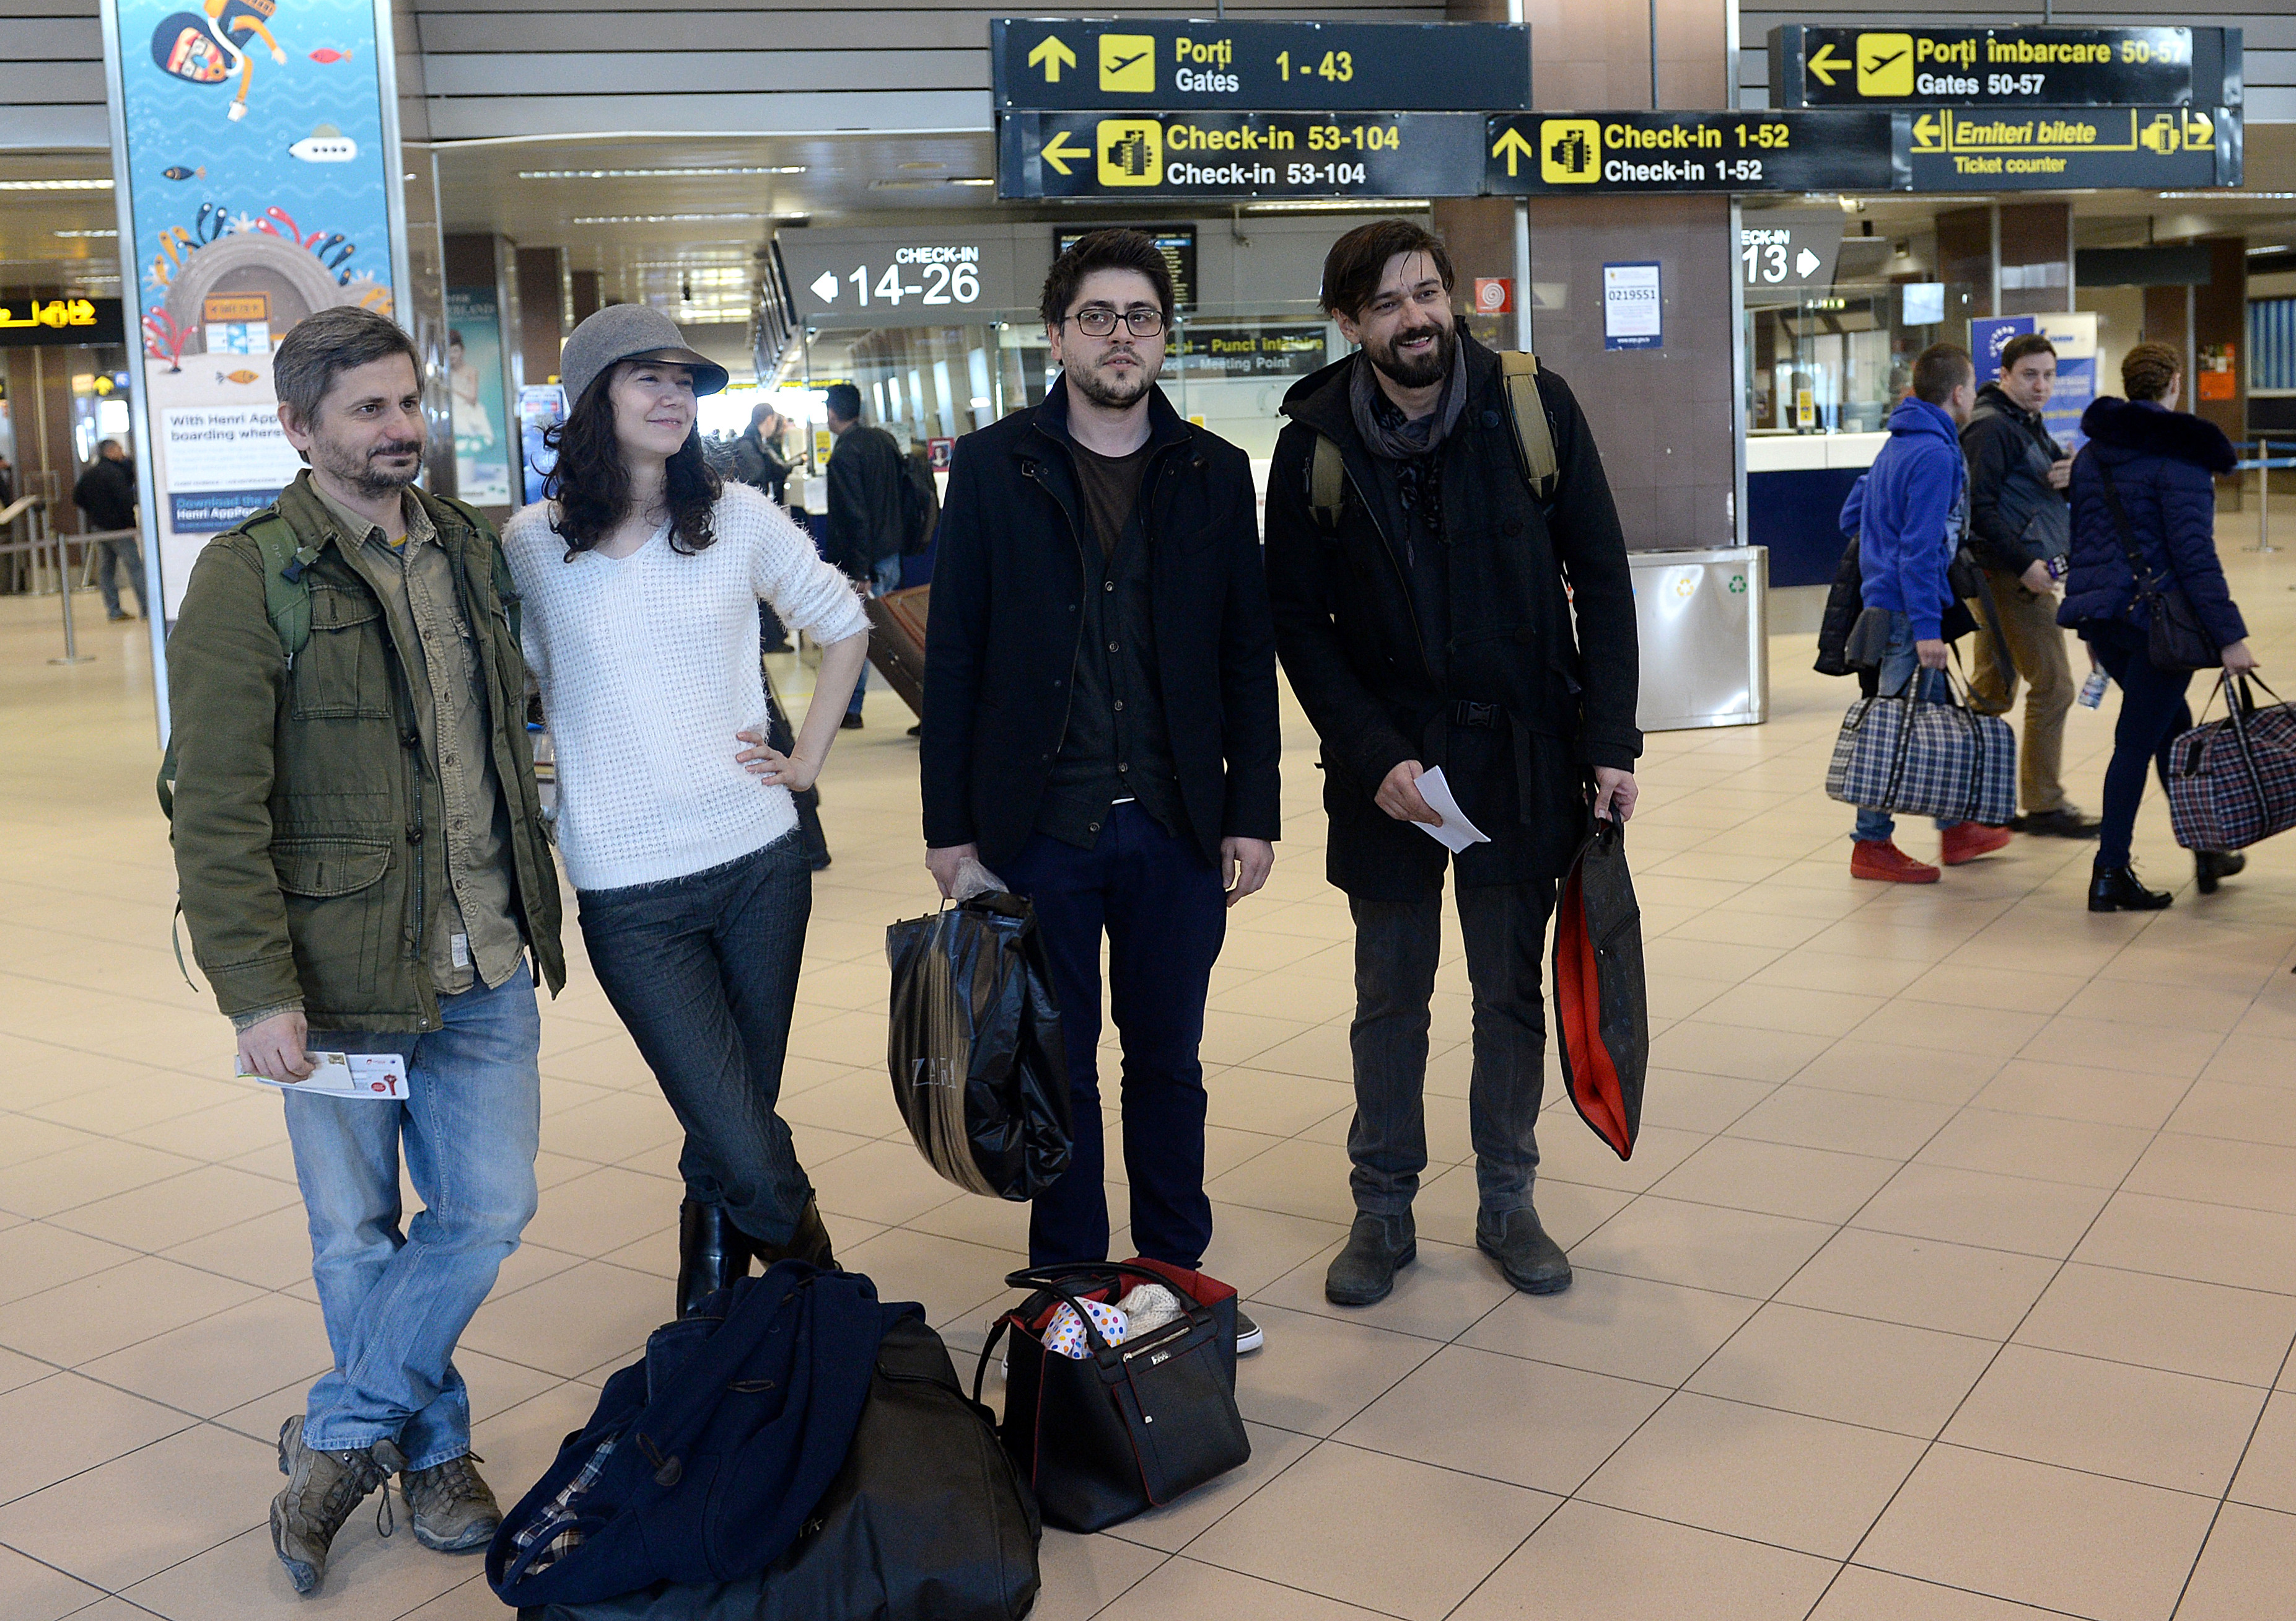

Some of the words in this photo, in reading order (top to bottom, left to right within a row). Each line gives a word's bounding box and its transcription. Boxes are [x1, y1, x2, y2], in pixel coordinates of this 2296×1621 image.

[1176, 37, 1232, 71] Porți
[1276, 51, 1289, 81] 1
[1318, 51, 1354, 82] 43
[1917, 38, 1976, 71] Porți
[1986, 38, 2111, 63] îmbarcare
[2121, 40, 2186, 63] 50-57
[1175, 68, 1239, 92] Gates
[1917, 73, 1979, 95] Gates
[1987, 74, 2045, 95] 50-57
[1167, 125, 1294, 150] Check-in
[1308, 125, 1400, 150] 53-104
[1604, 124, 1722, 149] Check-in
[1735, 123, 1790, 148] 1-52
[1955, 121, 2033, 144] Emiteri
[2037, 121, 2097, 143] bilete
[1167, 162, 1276, 185] Check-in
[1287, 163, 1366, 185] 53-104
[1605, 159, 1705, 182] Check-in
[1715, 159, 1763, 180] 1-52
[1953, 156, 2003, 174] Ticket
[2005, 157, 2067, 173] counter
[896, 246, 979, 264] CHECK-IN
[1742, 244, 1788, 283] 13
[849, 261, 980, 307] 14-26
[1609, 289, 1655, 301] 0219551
[1212, 338, 1256, 353] Punct
[1200, 358, 1251, 372] Meeting
[1256, 356, 1290, 369] Point
[170, 414, 203, 425] With
[208, 414, 244, 424] Henri
[171, 429, 234, 441] boarding
[239, 428, 284, 438] where
[177, 507, 208, 520] Henri
